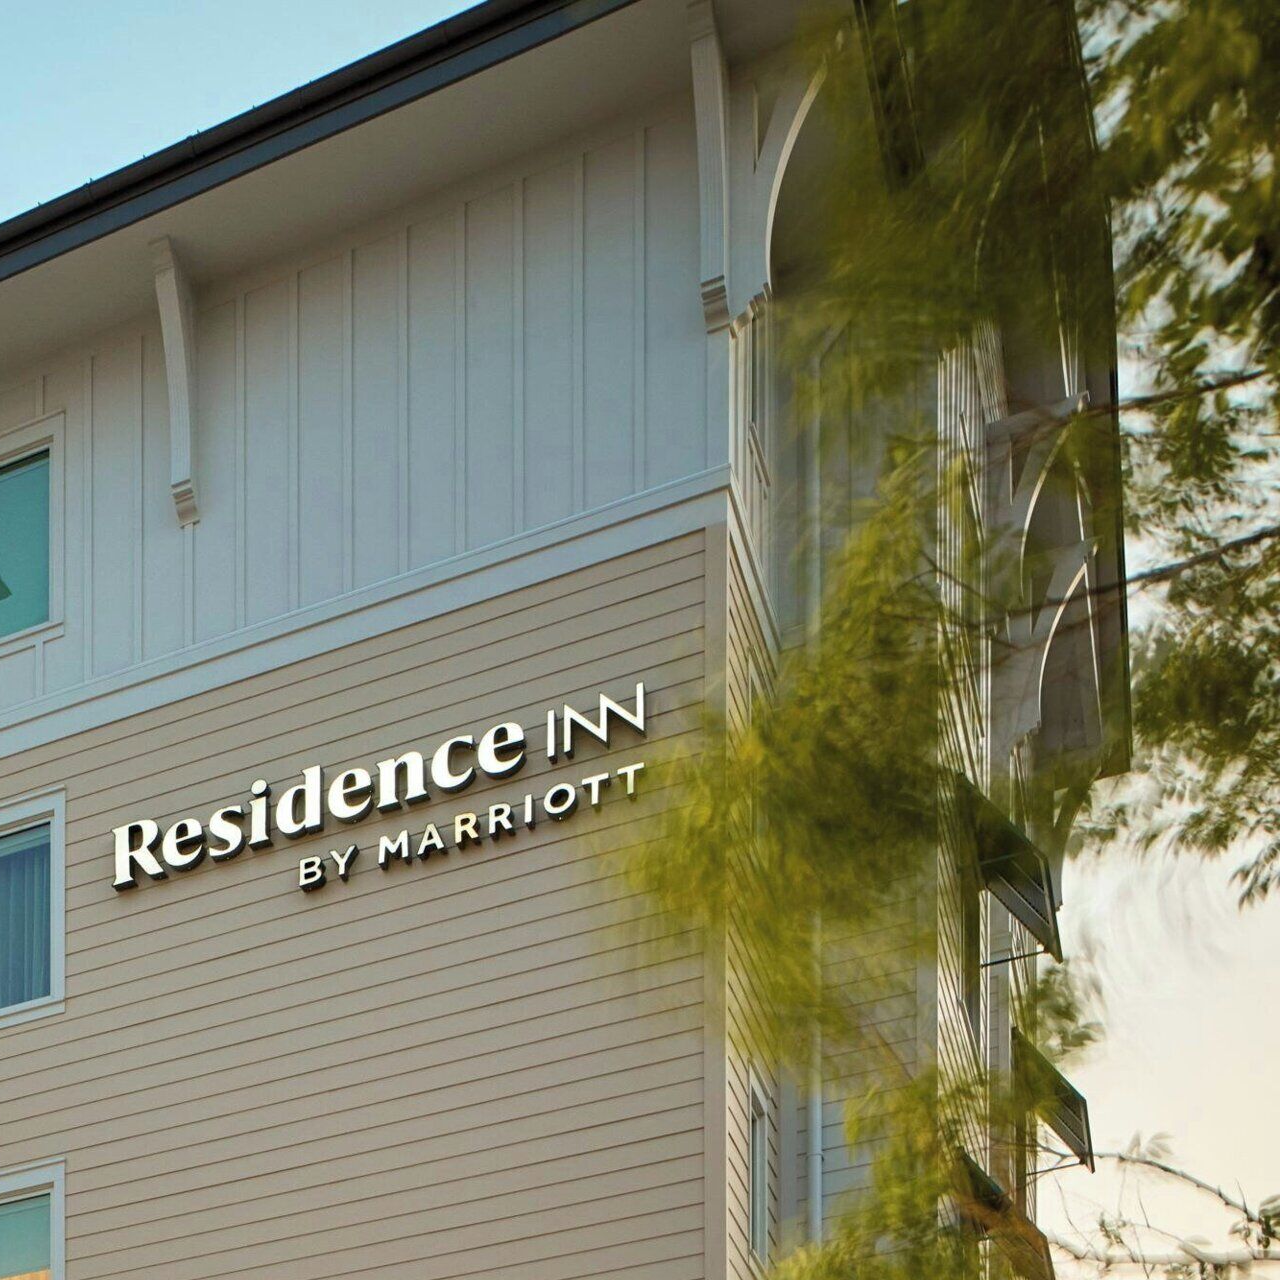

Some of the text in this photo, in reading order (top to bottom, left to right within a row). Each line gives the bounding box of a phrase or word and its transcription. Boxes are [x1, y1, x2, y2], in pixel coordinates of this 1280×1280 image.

[111, 681, 646, 890] Residence INN
[298, 762, 646, 891] BY MARRIOTT
